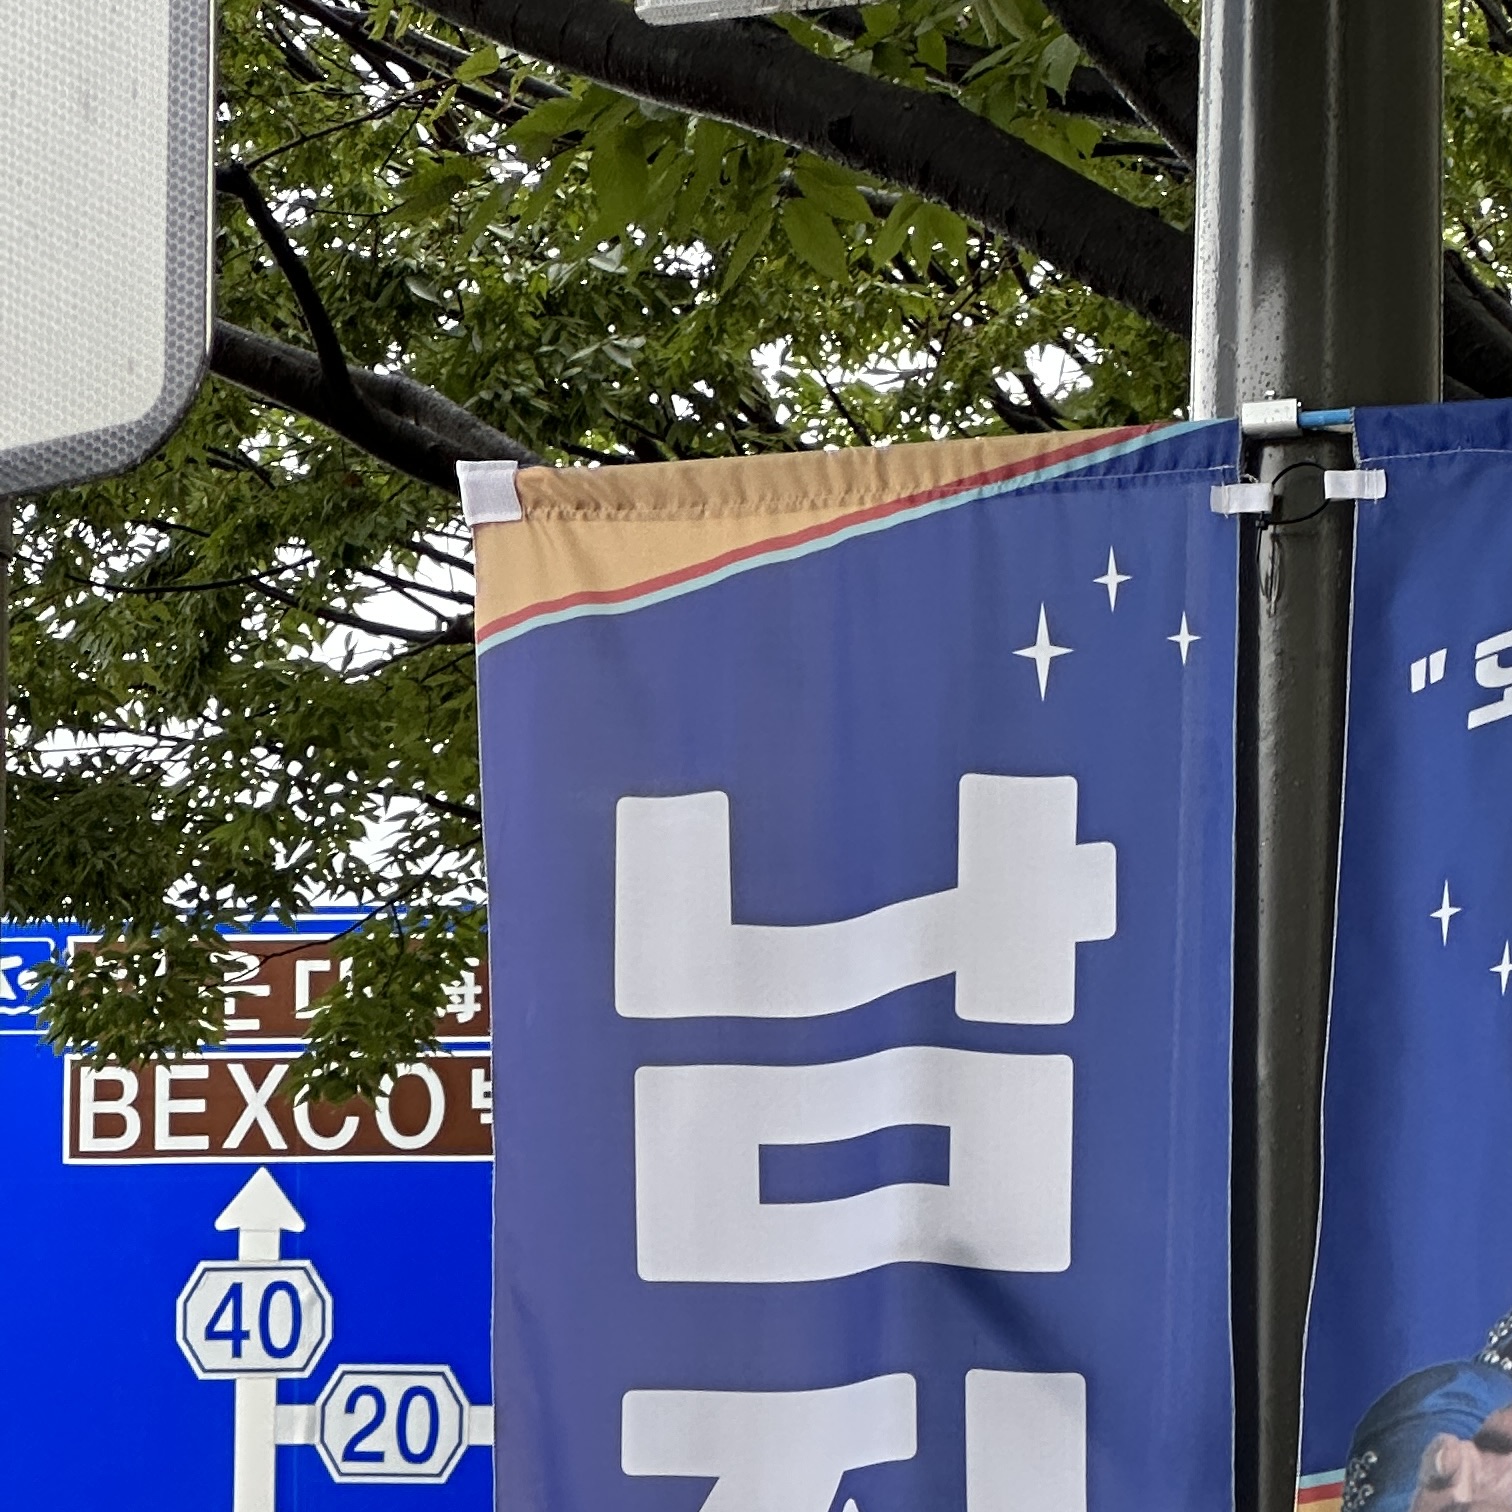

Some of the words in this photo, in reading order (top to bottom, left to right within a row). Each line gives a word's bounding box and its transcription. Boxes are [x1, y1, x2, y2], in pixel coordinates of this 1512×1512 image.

[78, 1062, 446, 1152] BEXCO
[203, 1280, 303, 1359] 40
[341, 1385, 440, 1464] 20
